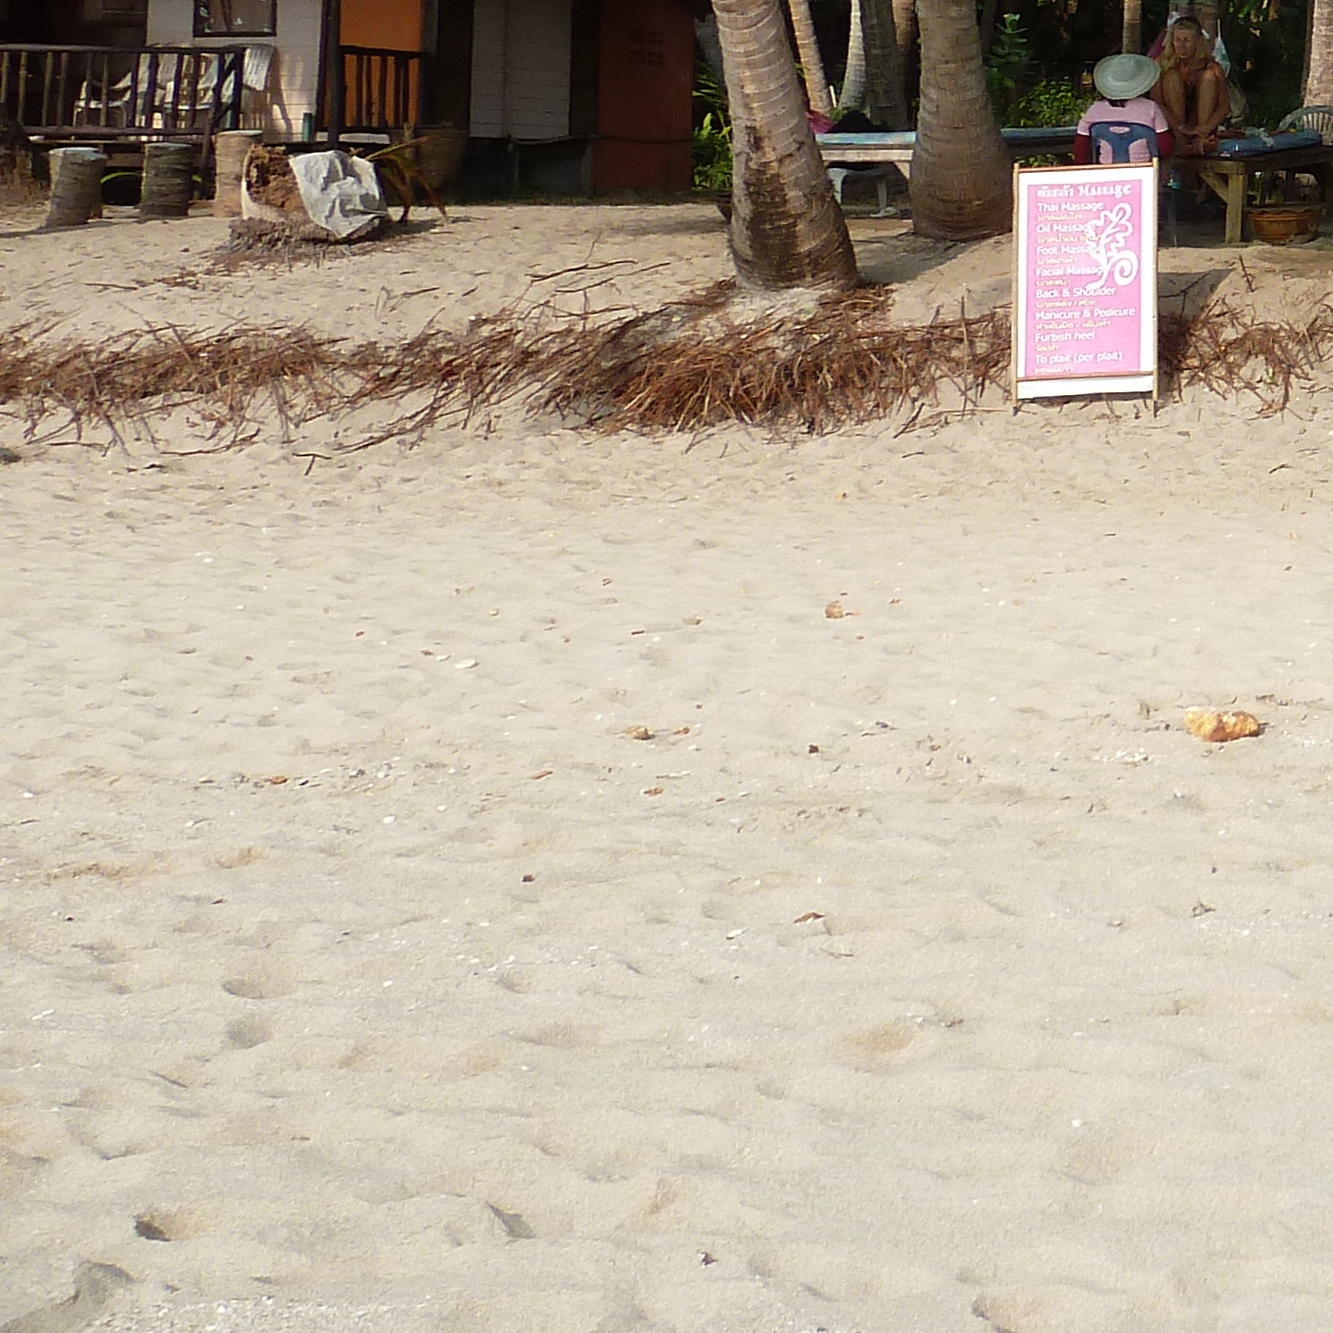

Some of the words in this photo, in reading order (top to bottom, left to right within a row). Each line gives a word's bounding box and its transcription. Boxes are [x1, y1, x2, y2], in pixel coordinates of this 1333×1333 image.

[1079, 184, 1132, 199] Massage
[1038, 203, 1059, 212] Thai
[1062, 202, 1104, 212] Massage
[1037, 225, 1051, 233] Oil
[1037, 246, 1058, 255] Foot
[1062, 246, 1101, 255] Massag
[1037, 268, 1064, 277] Facial
[1066, 267, 1104, 277] Massag
[1037, 290, 1060, 298] Back
[1063, 289, 1071, 298] &
[1074, 287, 1117, 297] Shoulder
[1036, 311, 1081, 319] Manicure
[1083, 310, 1091, 318] &
[1095, 309, 1136, 318] Pedicure
[1036, 333, 1071, 342] Furbish
[1075, 331, 1096, 340] heel
[1036, 355, 1047, 364] To
[1050, 354, 1071, 364] plait
[1074, 353, 1094, 363] (per
[1097, 352, 1123, 363] plait)
